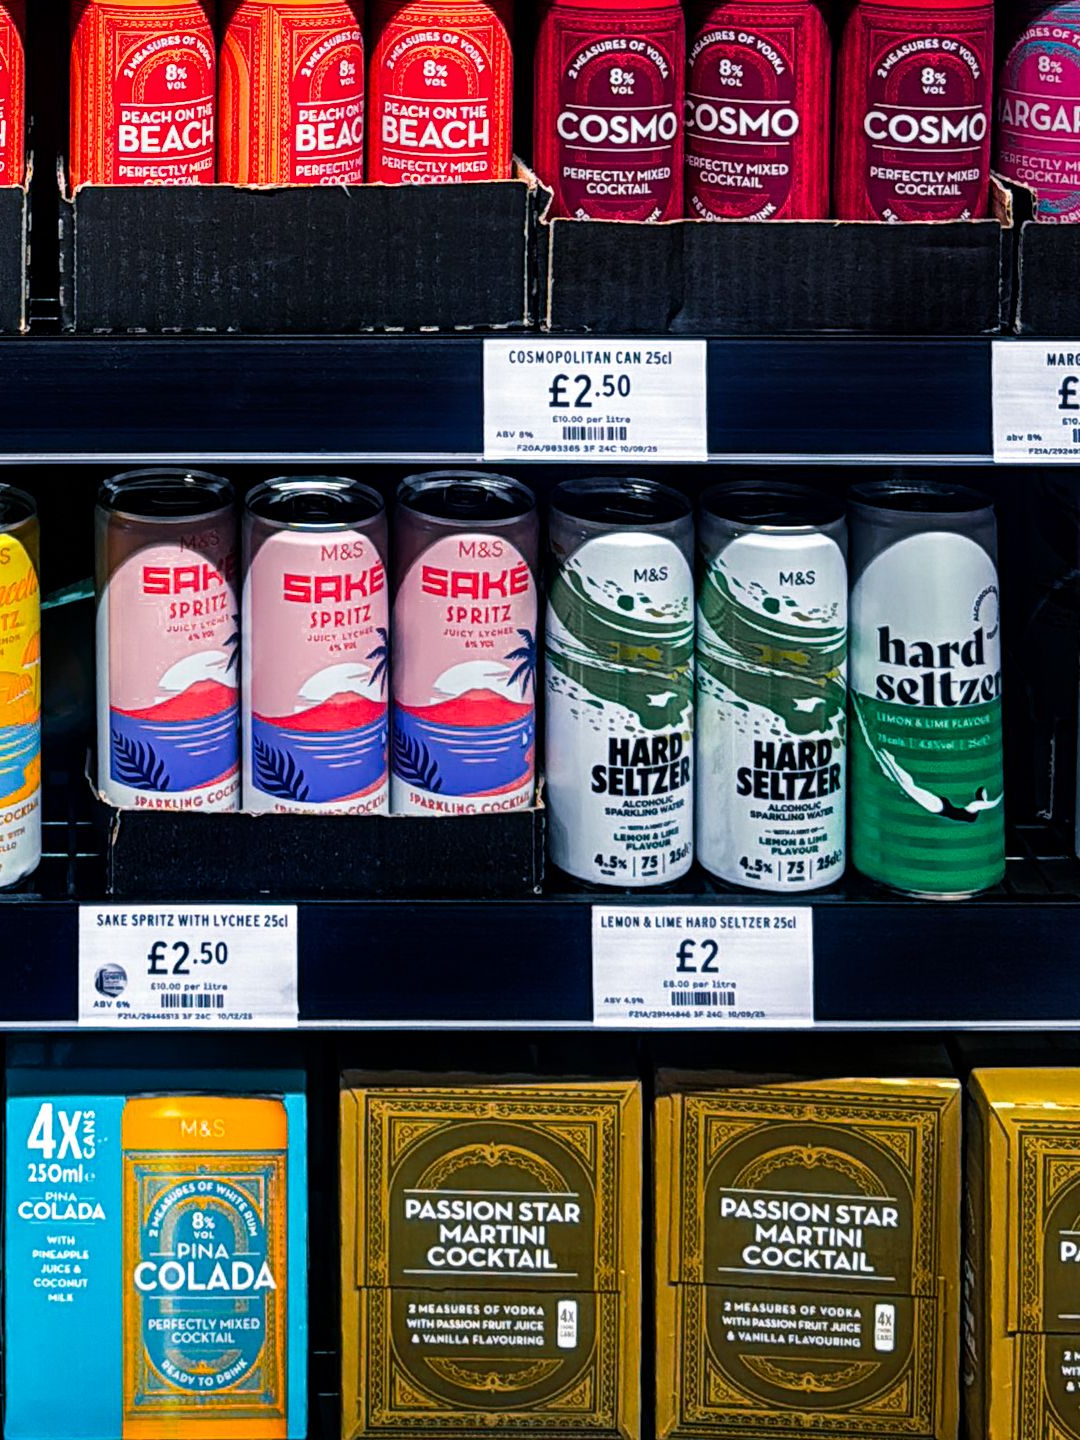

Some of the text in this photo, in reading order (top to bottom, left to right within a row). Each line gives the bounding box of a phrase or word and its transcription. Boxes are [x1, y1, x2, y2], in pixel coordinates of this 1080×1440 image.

[557, 112, 677, 144] COSMO
[509, 351, 671, 364] COSMOPOLITAN CAN 25cl
[549, 374, 630, 407] £2.50
[421, 562, 529, 599] SAKÉ
[780, 570, 815, 586] M&S
[446, 604, 511, 623] SPRITZ
[444, 628, 514, 638] JUICY LYCHEE
[877, 626, 985, 669] hard
[875, 670, 1002, 706] seltzer
[754, 739, 832, 771] HARD
[737, 764, 840, 800] SELTZER
[97, 914, 287, 927] SAKE SPRITZ WITH LYCHEE 25cl
[601, 916, 796, 929] LEMON & LIME HARD SELTZER 25cl
[148, 941, 228, 974] £2.50
[676, 939, 718, 972] £2
[45, 1192, 76, 1202] PINA
[18, 1202, 106, 1221] COLADA
[405, 1199, 580, 1223] PASSION STAR
[439, 1223, 546, 1245] MARTINI
[33, 1250, 89, 1259] PINEAPPLE
[427, 1246, 557, 1269] COCKTAIL
[408, 1304, 544, 1316] 2 MEASURES OF VODKA
[407, 1319, 544, 1331] WITH PASSION FRUIT JUICE
[411, 1334, 544, 1346] & VANILLA FLAVOURING
